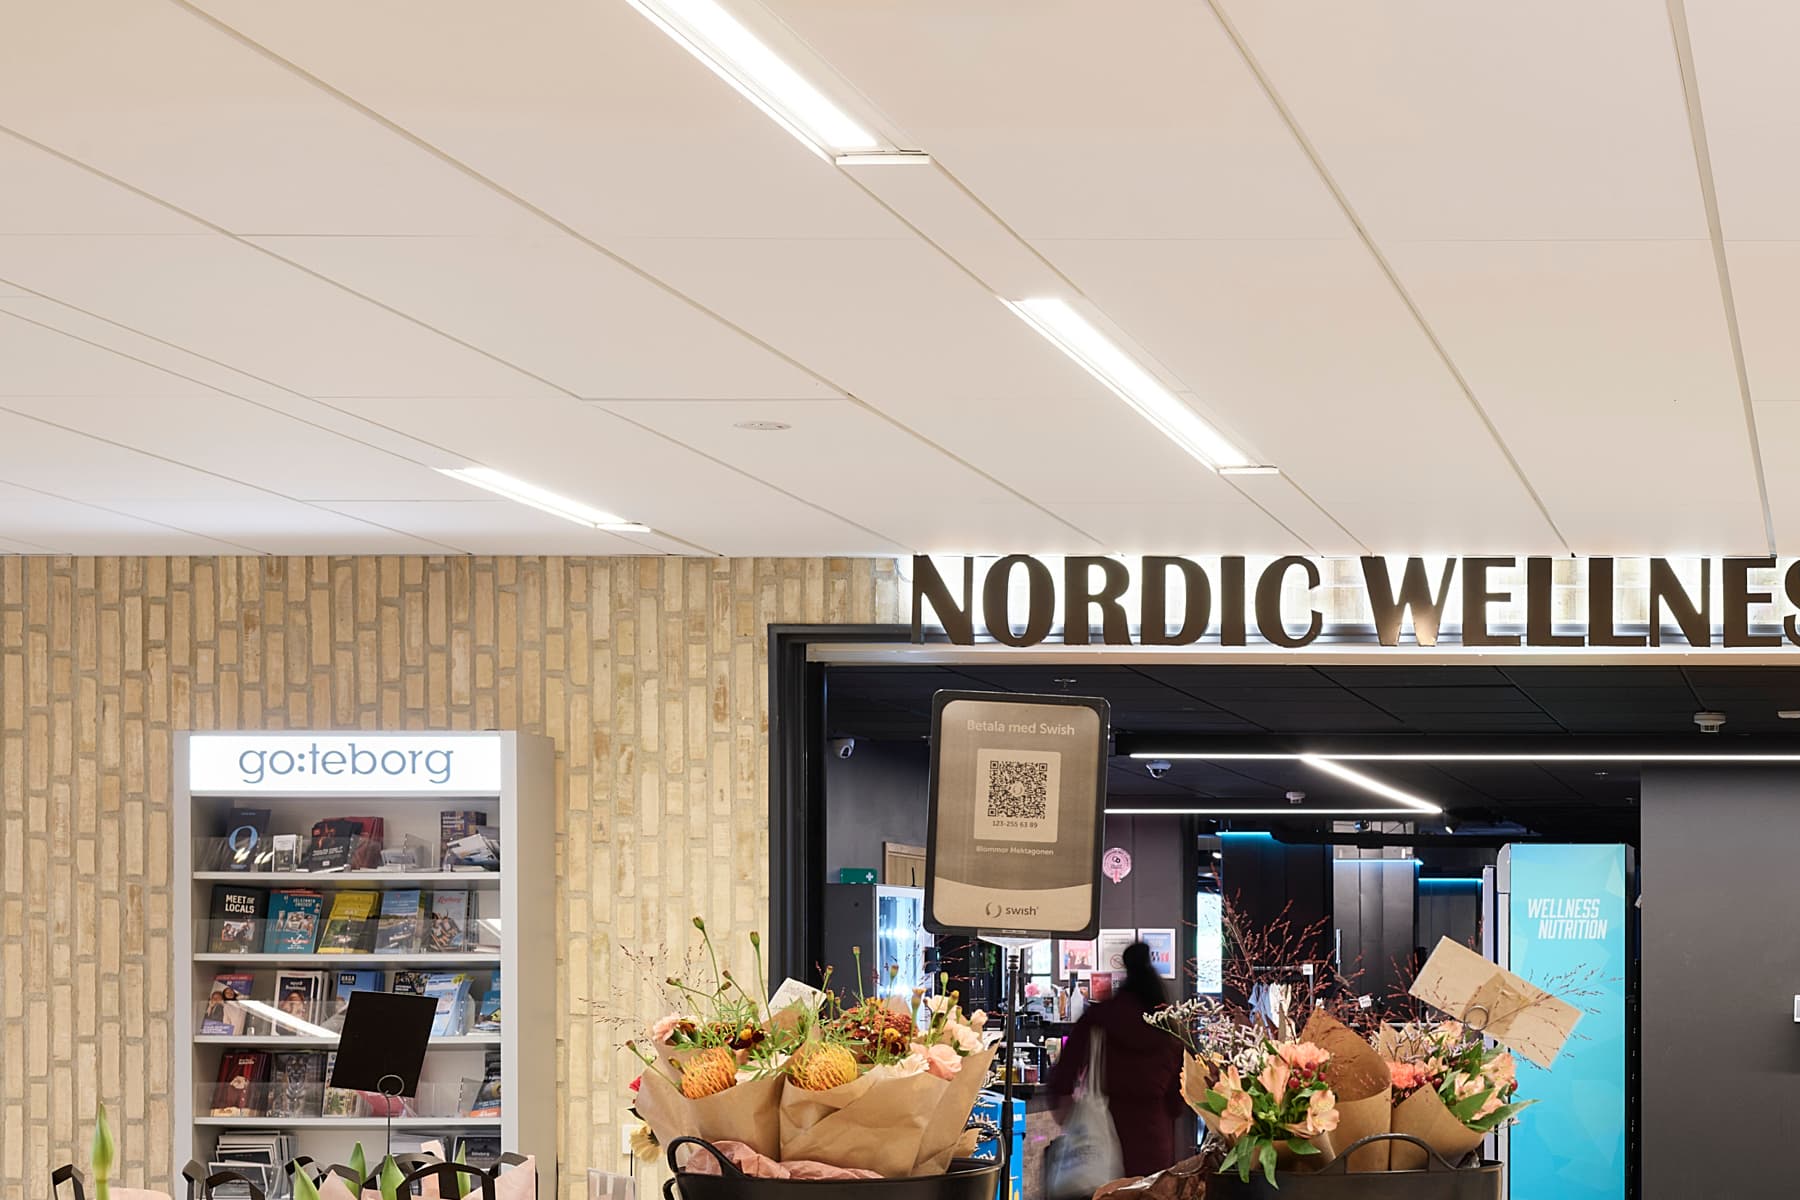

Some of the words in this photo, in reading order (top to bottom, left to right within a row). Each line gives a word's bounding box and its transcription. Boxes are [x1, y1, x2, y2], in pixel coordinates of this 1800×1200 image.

[911, 554, 1323, 648] NORDIC
[967, 719, 1005, 732] Betala
[1008, 722, 1036, 734] med
[1040, 723, 1075, 735] Swish
[239, 743, 454, 784] go:teborg
[226, 894, 247, 904] MEET
[1528, 898, 1600, 918] WELLNESS
[225, 903, 255, 914] LOCALS
[1005, 906, 1037, 916] swish
[1538, 919, 1608, 940] NUTRITION
